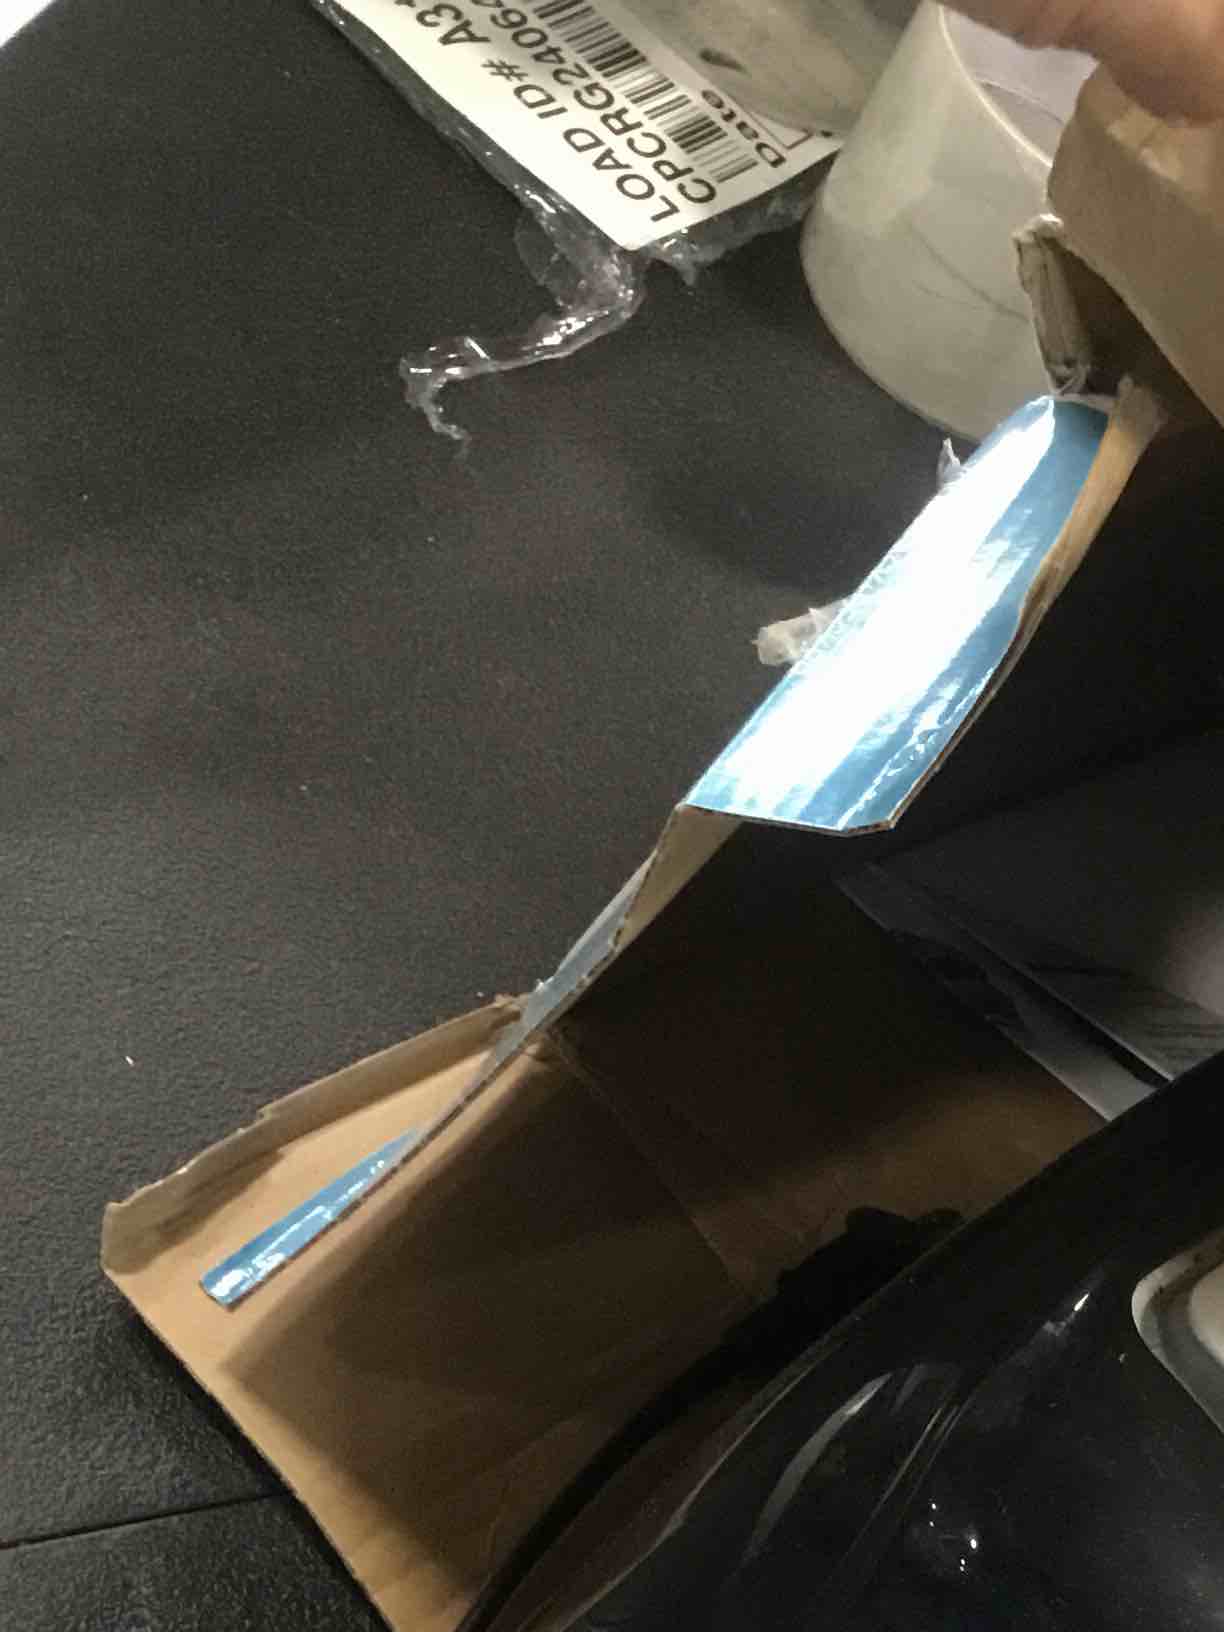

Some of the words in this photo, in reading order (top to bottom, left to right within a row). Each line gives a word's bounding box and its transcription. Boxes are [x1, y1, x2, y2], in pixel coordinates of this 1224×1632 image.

[481, 59, 568, 120] ID#
[701, 89, 787, 169] Date
[563, 126, 681, 223] LOAD
